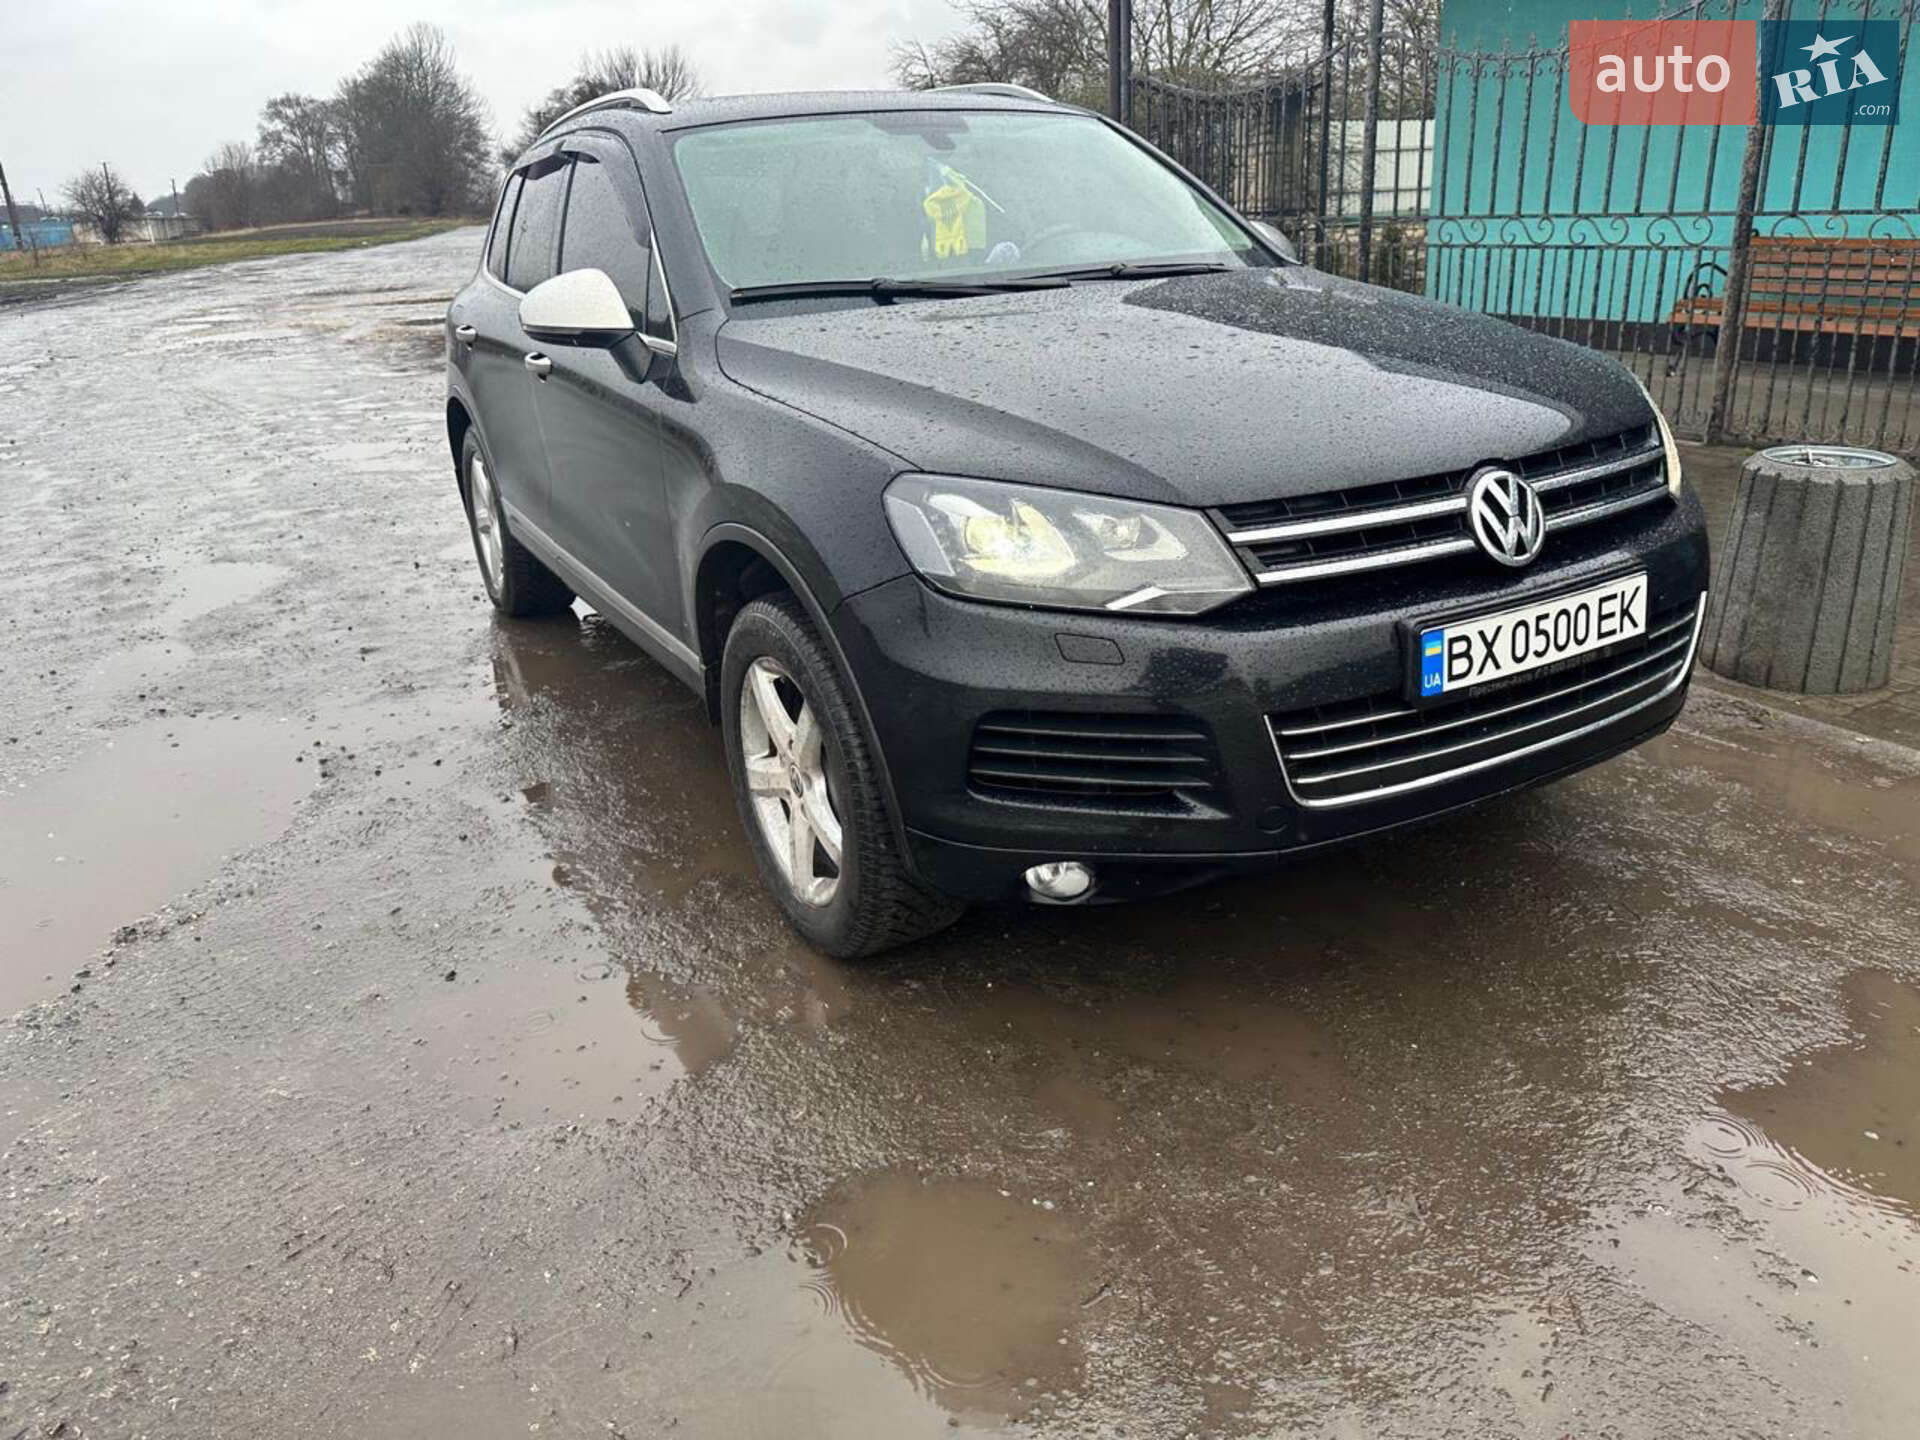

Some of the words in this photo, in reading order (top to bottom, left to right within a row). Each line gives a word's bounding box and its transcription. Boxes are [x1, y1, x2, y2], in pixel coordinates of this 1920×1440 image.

[1447, 625, 1503, 683] BX
[1511, 603, 1591, 664] 0500
[1597, 586, 1641, 640] EK
[1424, 673, 1442, 688] UA
